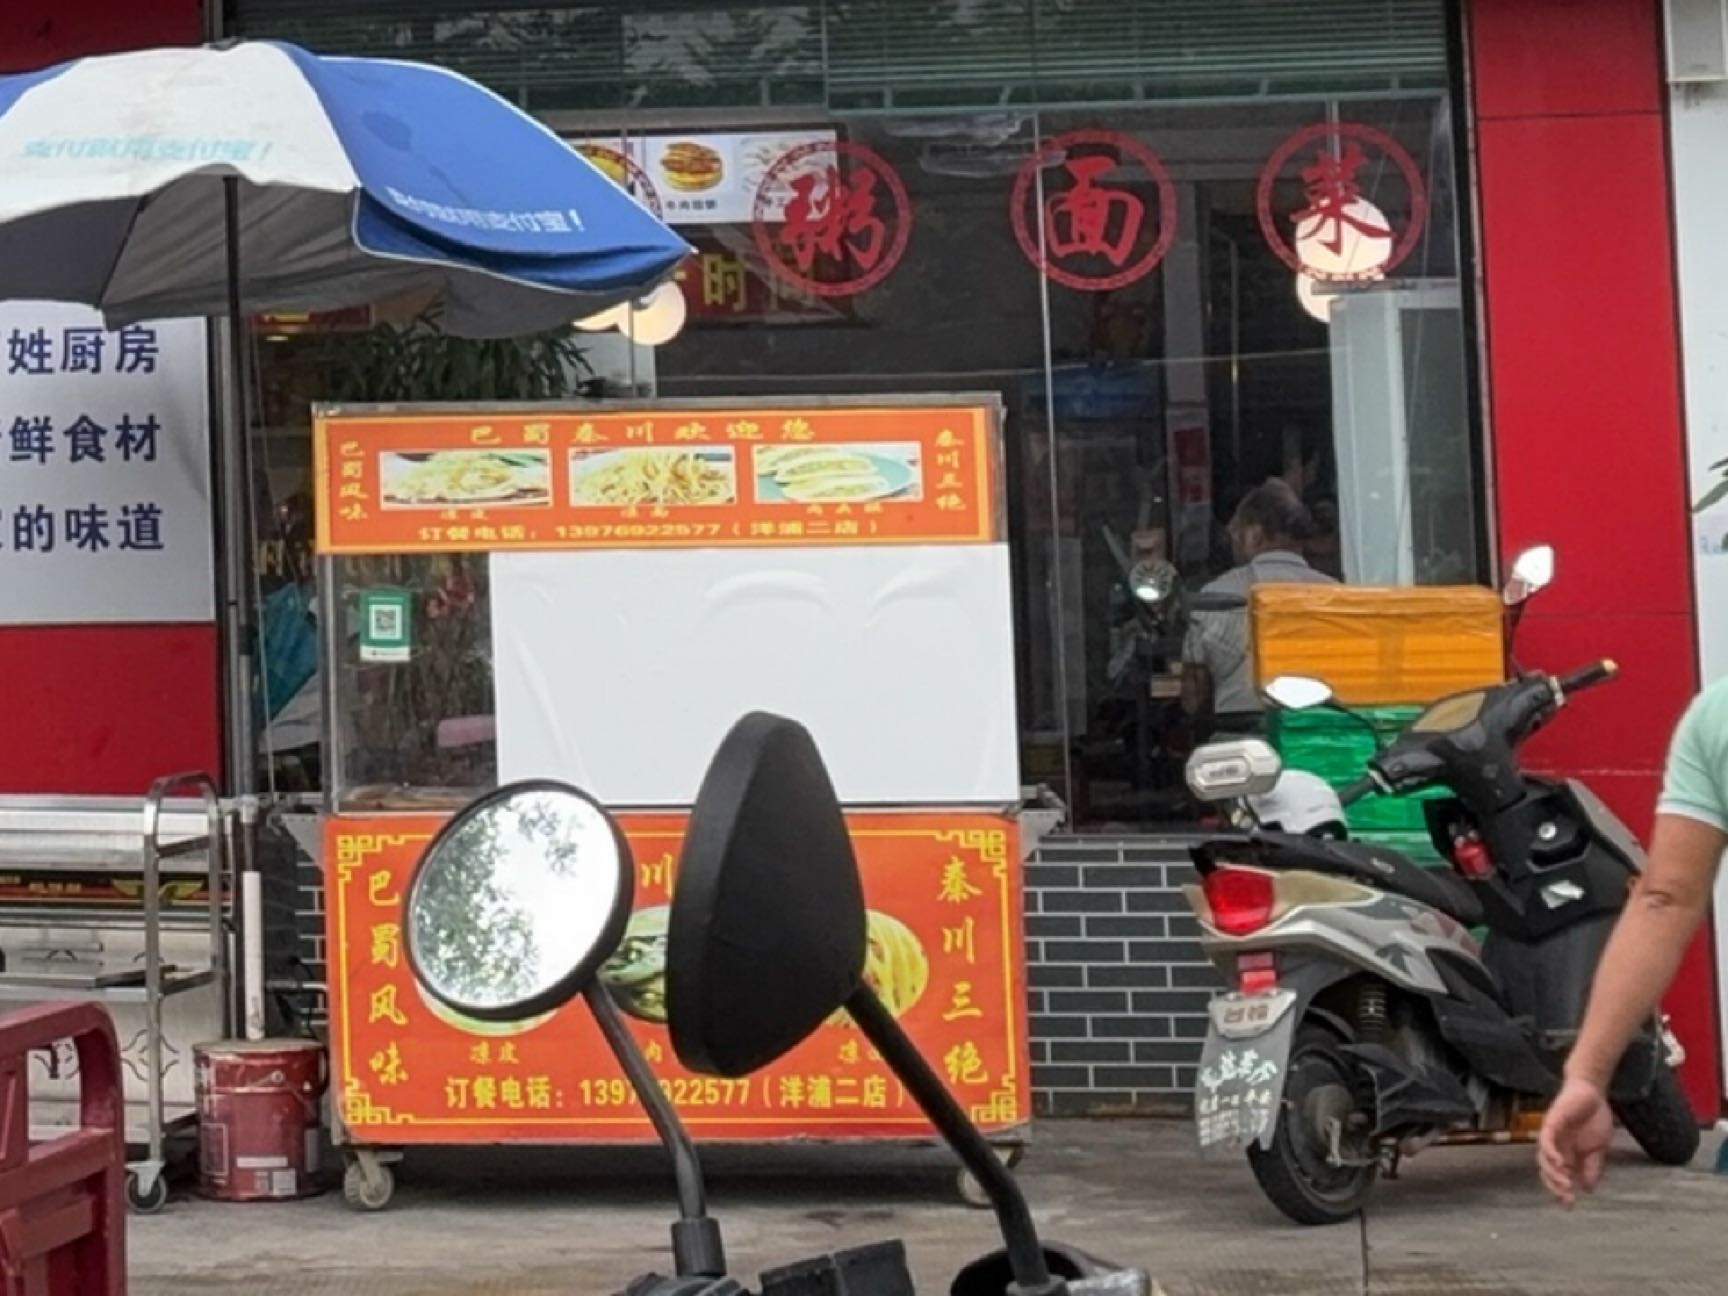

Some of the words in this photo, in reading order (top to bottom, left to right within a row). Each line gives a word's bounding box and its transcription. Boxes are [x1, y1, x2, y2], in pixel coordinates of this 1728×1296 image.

[780, 164, 885, 271] 粥
[1045, 155, 1144, 268] 面
[1289, 142, 1399, 257] 菜
[470, 418, 816, 445] 巴蜀秦川欢迎您
[368, 869, 410, 1086] 巴蜀风味
[936, 854, 989, 1086] 秦川三绝
